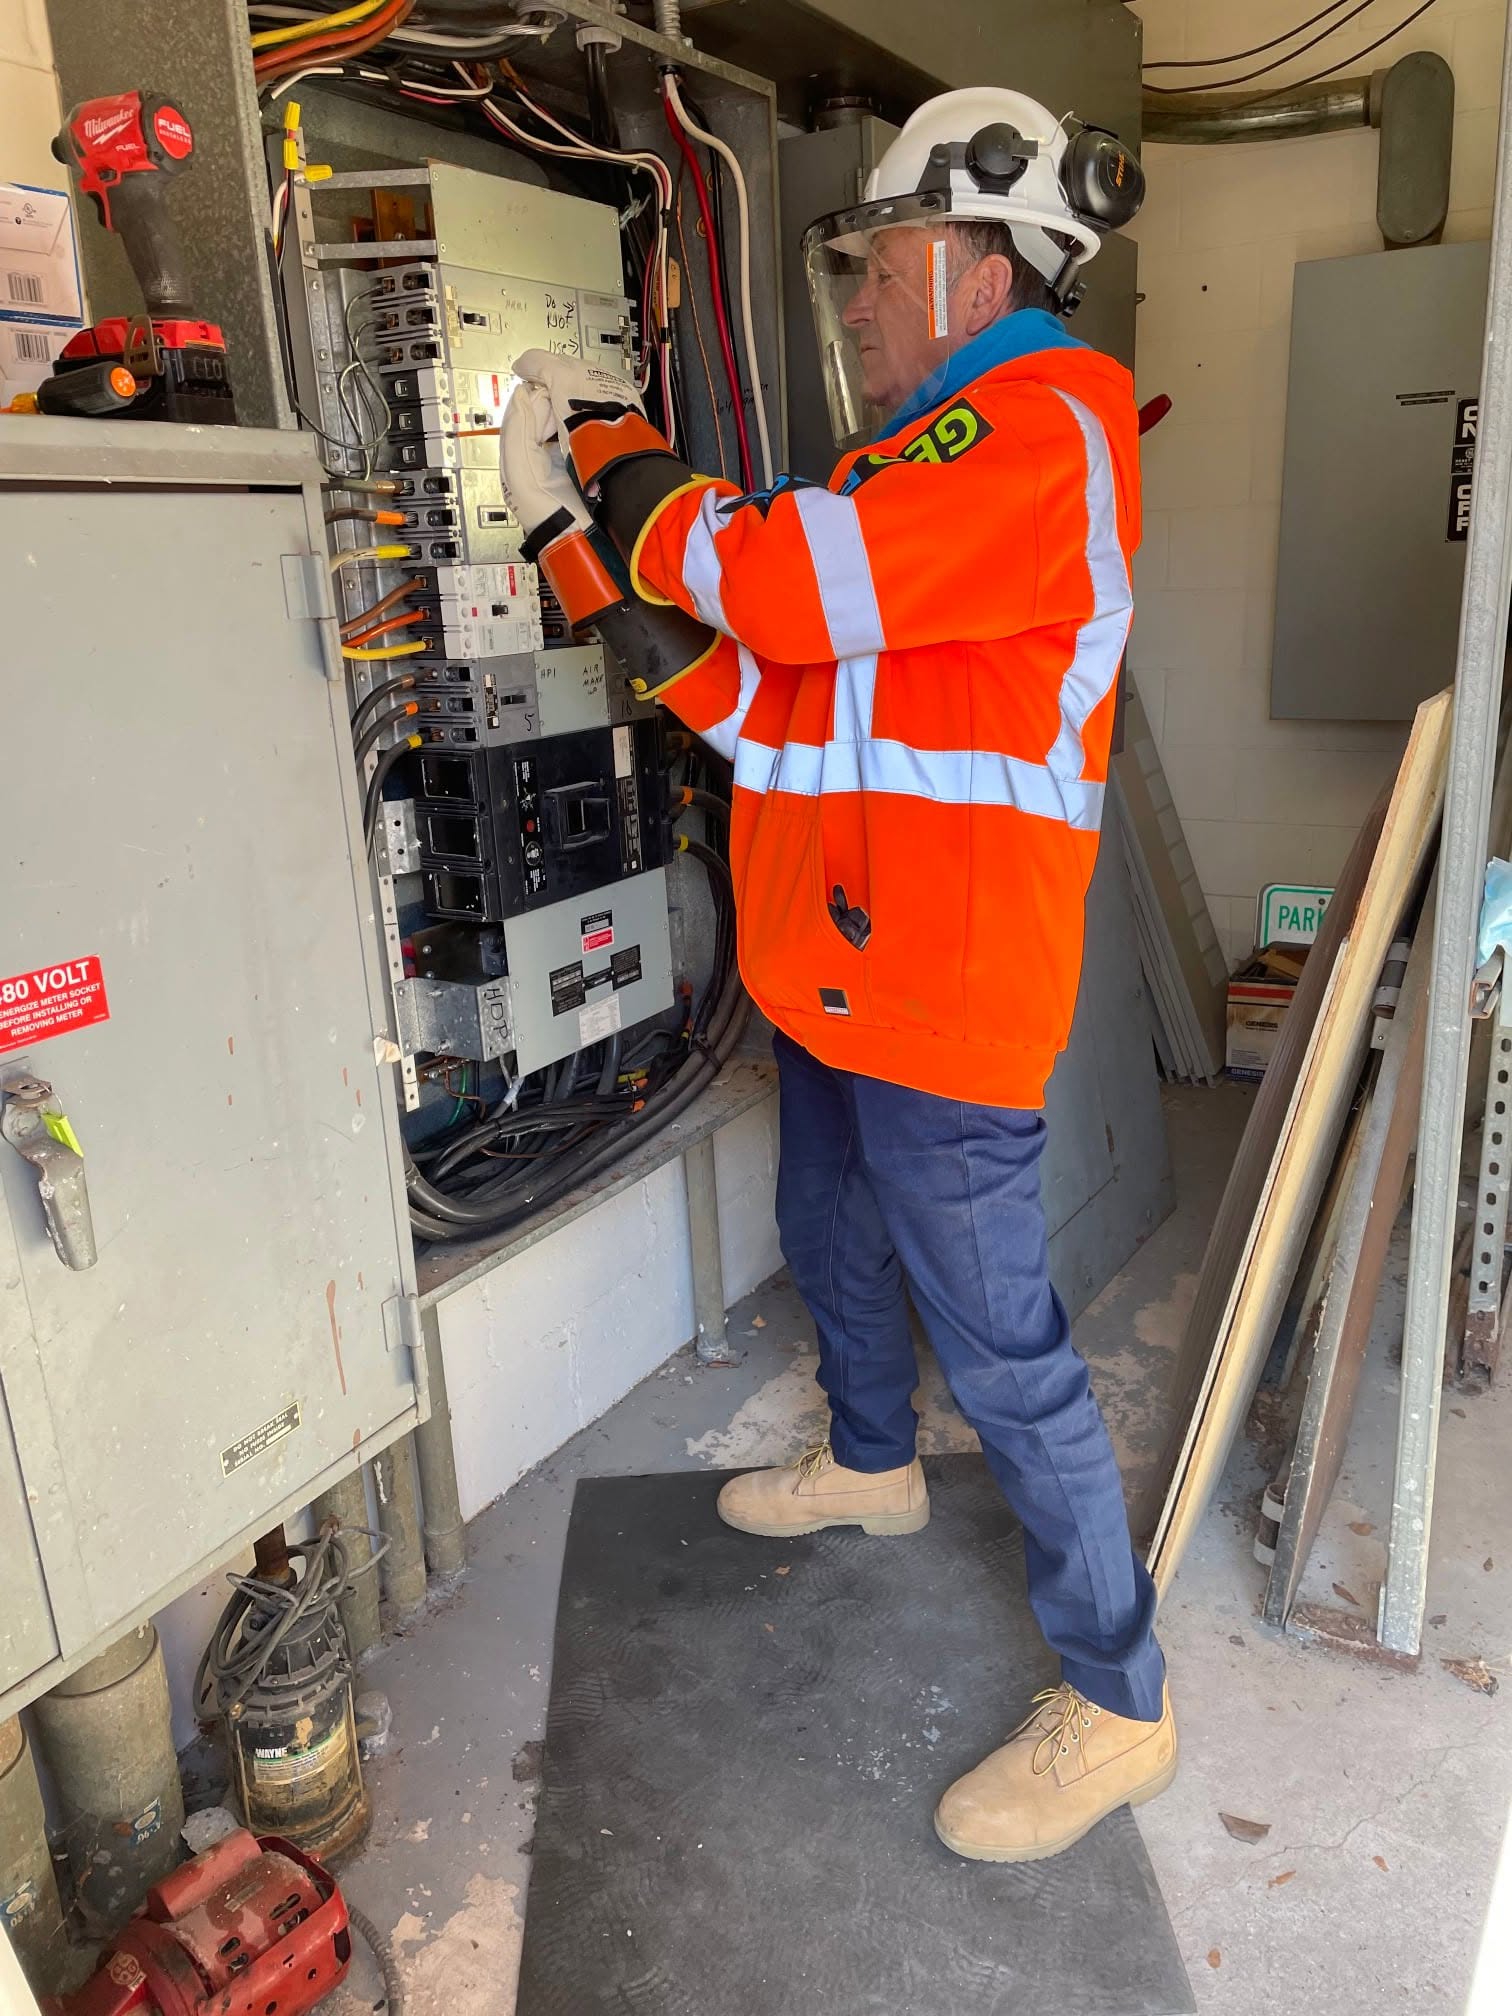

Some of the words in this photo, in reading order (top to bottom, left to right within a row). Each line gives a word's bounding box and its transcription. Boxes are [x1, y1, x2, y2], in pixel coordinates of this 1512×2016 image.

[84, 108, 134, 138] Milwaukee
[158, 118, 192, 138] FUEL
[115, 143, 141, 152] FUEL
[583, 663, 599, 676] AIR
[0, 980, 29, 1005] 80
[33, 961, 90, 993] VOLT
[41, 992, 68, 1006] METER
[69, 983, 101, 998] SOCKET
[32, 1000, 79, 1019] INSTALLING
[80, 996, 93, 1005] OR
[10, 1017, 55, 1037] REMOVING
[56, 1009, 84, 1023] METER
[255, 1746, 289, 1759] WAYNE
